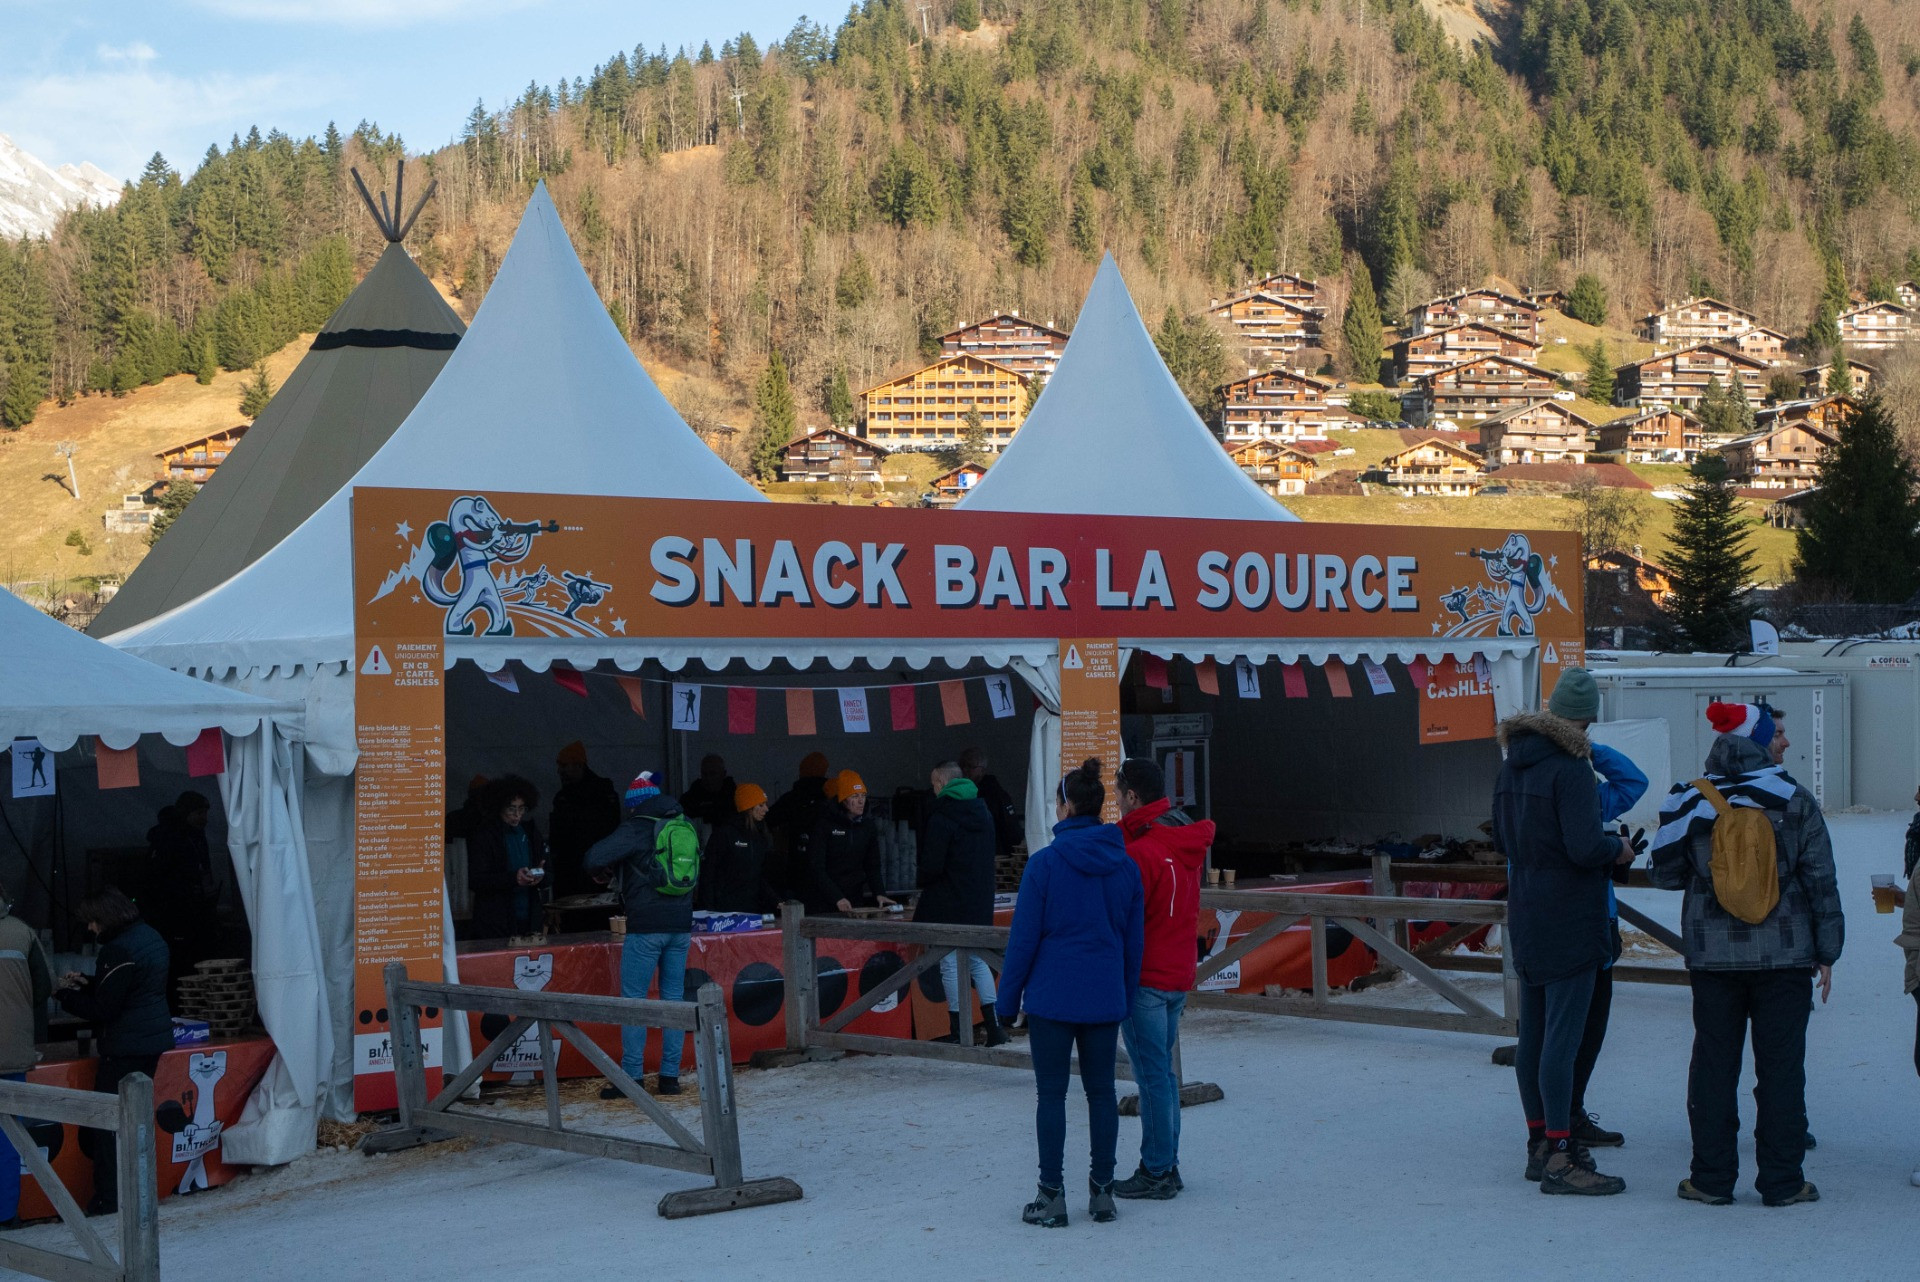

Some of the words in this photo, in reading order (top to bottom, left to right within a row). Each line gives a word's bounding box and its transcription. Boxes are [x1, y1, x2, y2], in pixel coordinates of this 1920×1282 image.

[650, 536, 911, 606] SNACK
[934, 544, 1070, 608] BAR
[1096, 549, 1175, 609] LA
[1196, 550, 1418, 610] SOURCE
[712, 918, 735, 932] Milka
